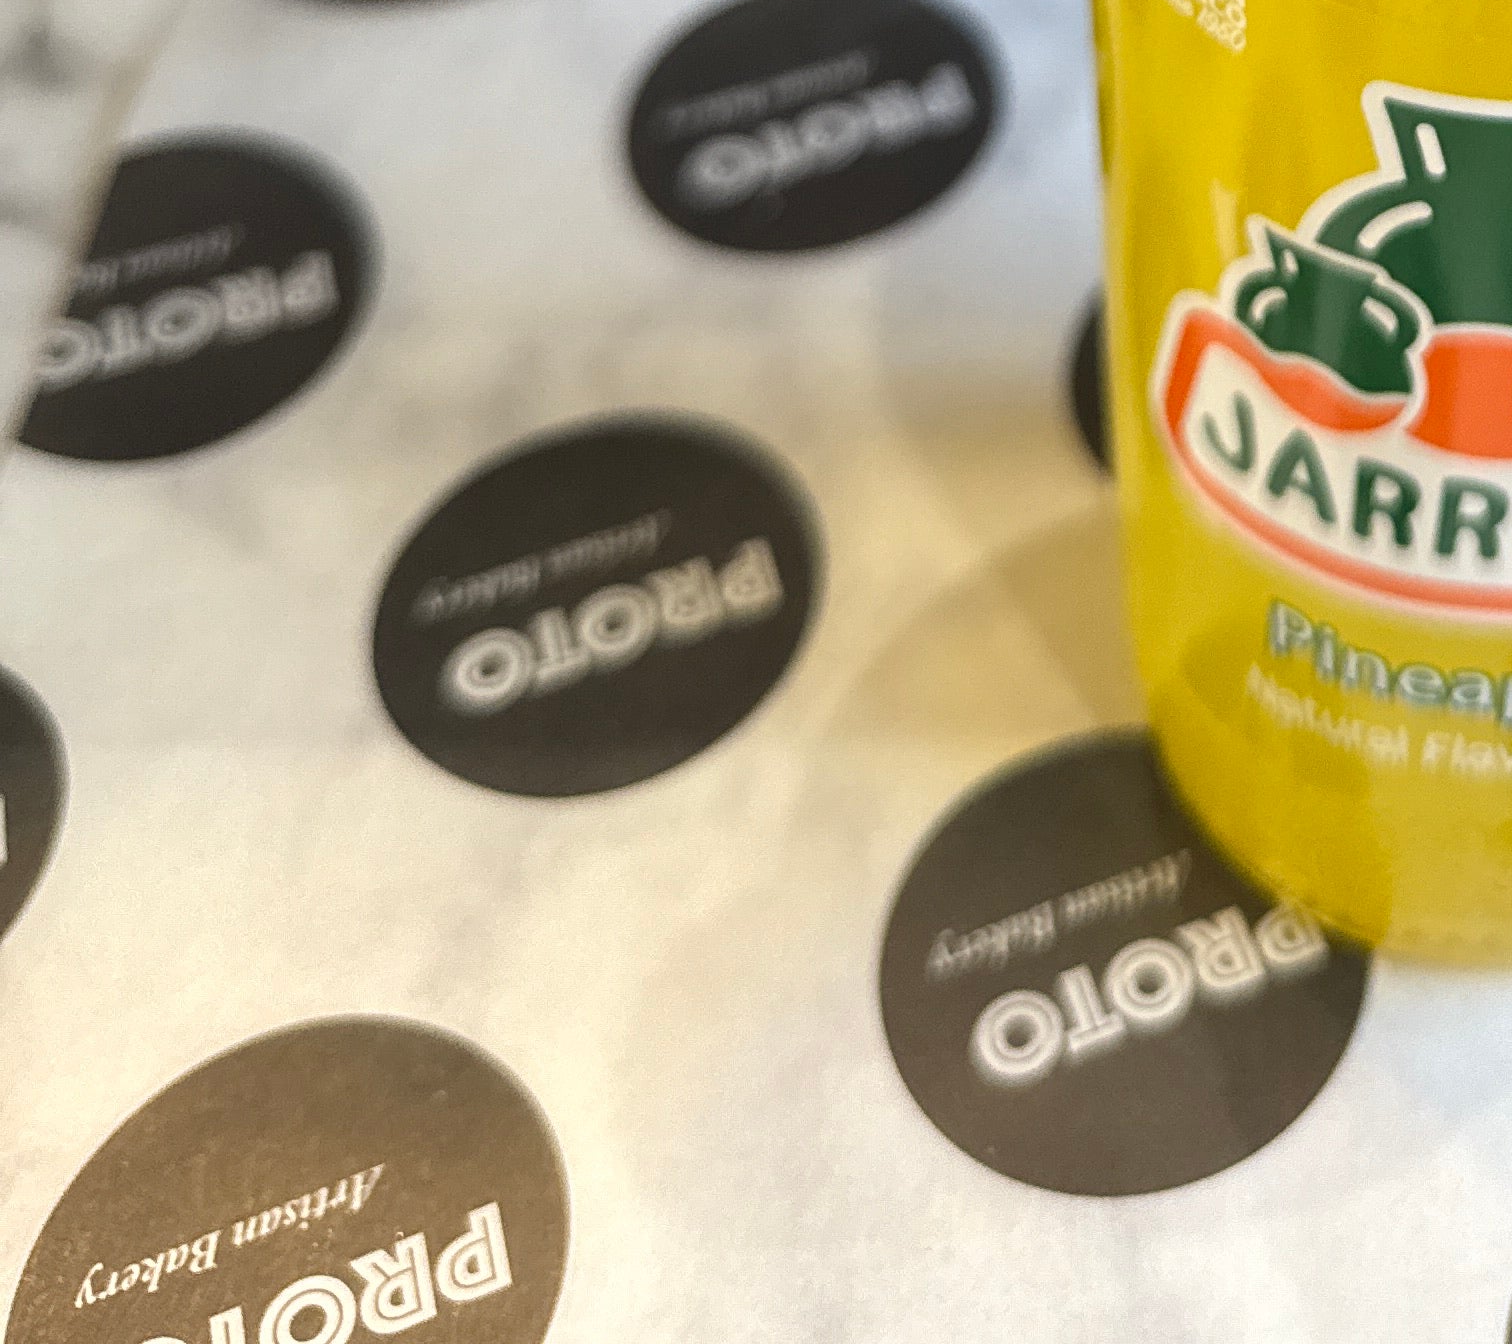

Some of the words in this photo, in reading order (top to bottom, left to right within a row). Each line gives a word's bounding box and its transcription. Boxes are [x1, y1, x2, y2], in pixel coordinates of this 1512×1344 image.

[437, 536, 783, 714] PROTO
[1246, 664, 1408, 767] Natural
[968, 894, 1332, 1085] PROTO
[231, 1163, 385, 1247] Artisan
[75, 1226, 220, 1309] Bakery
